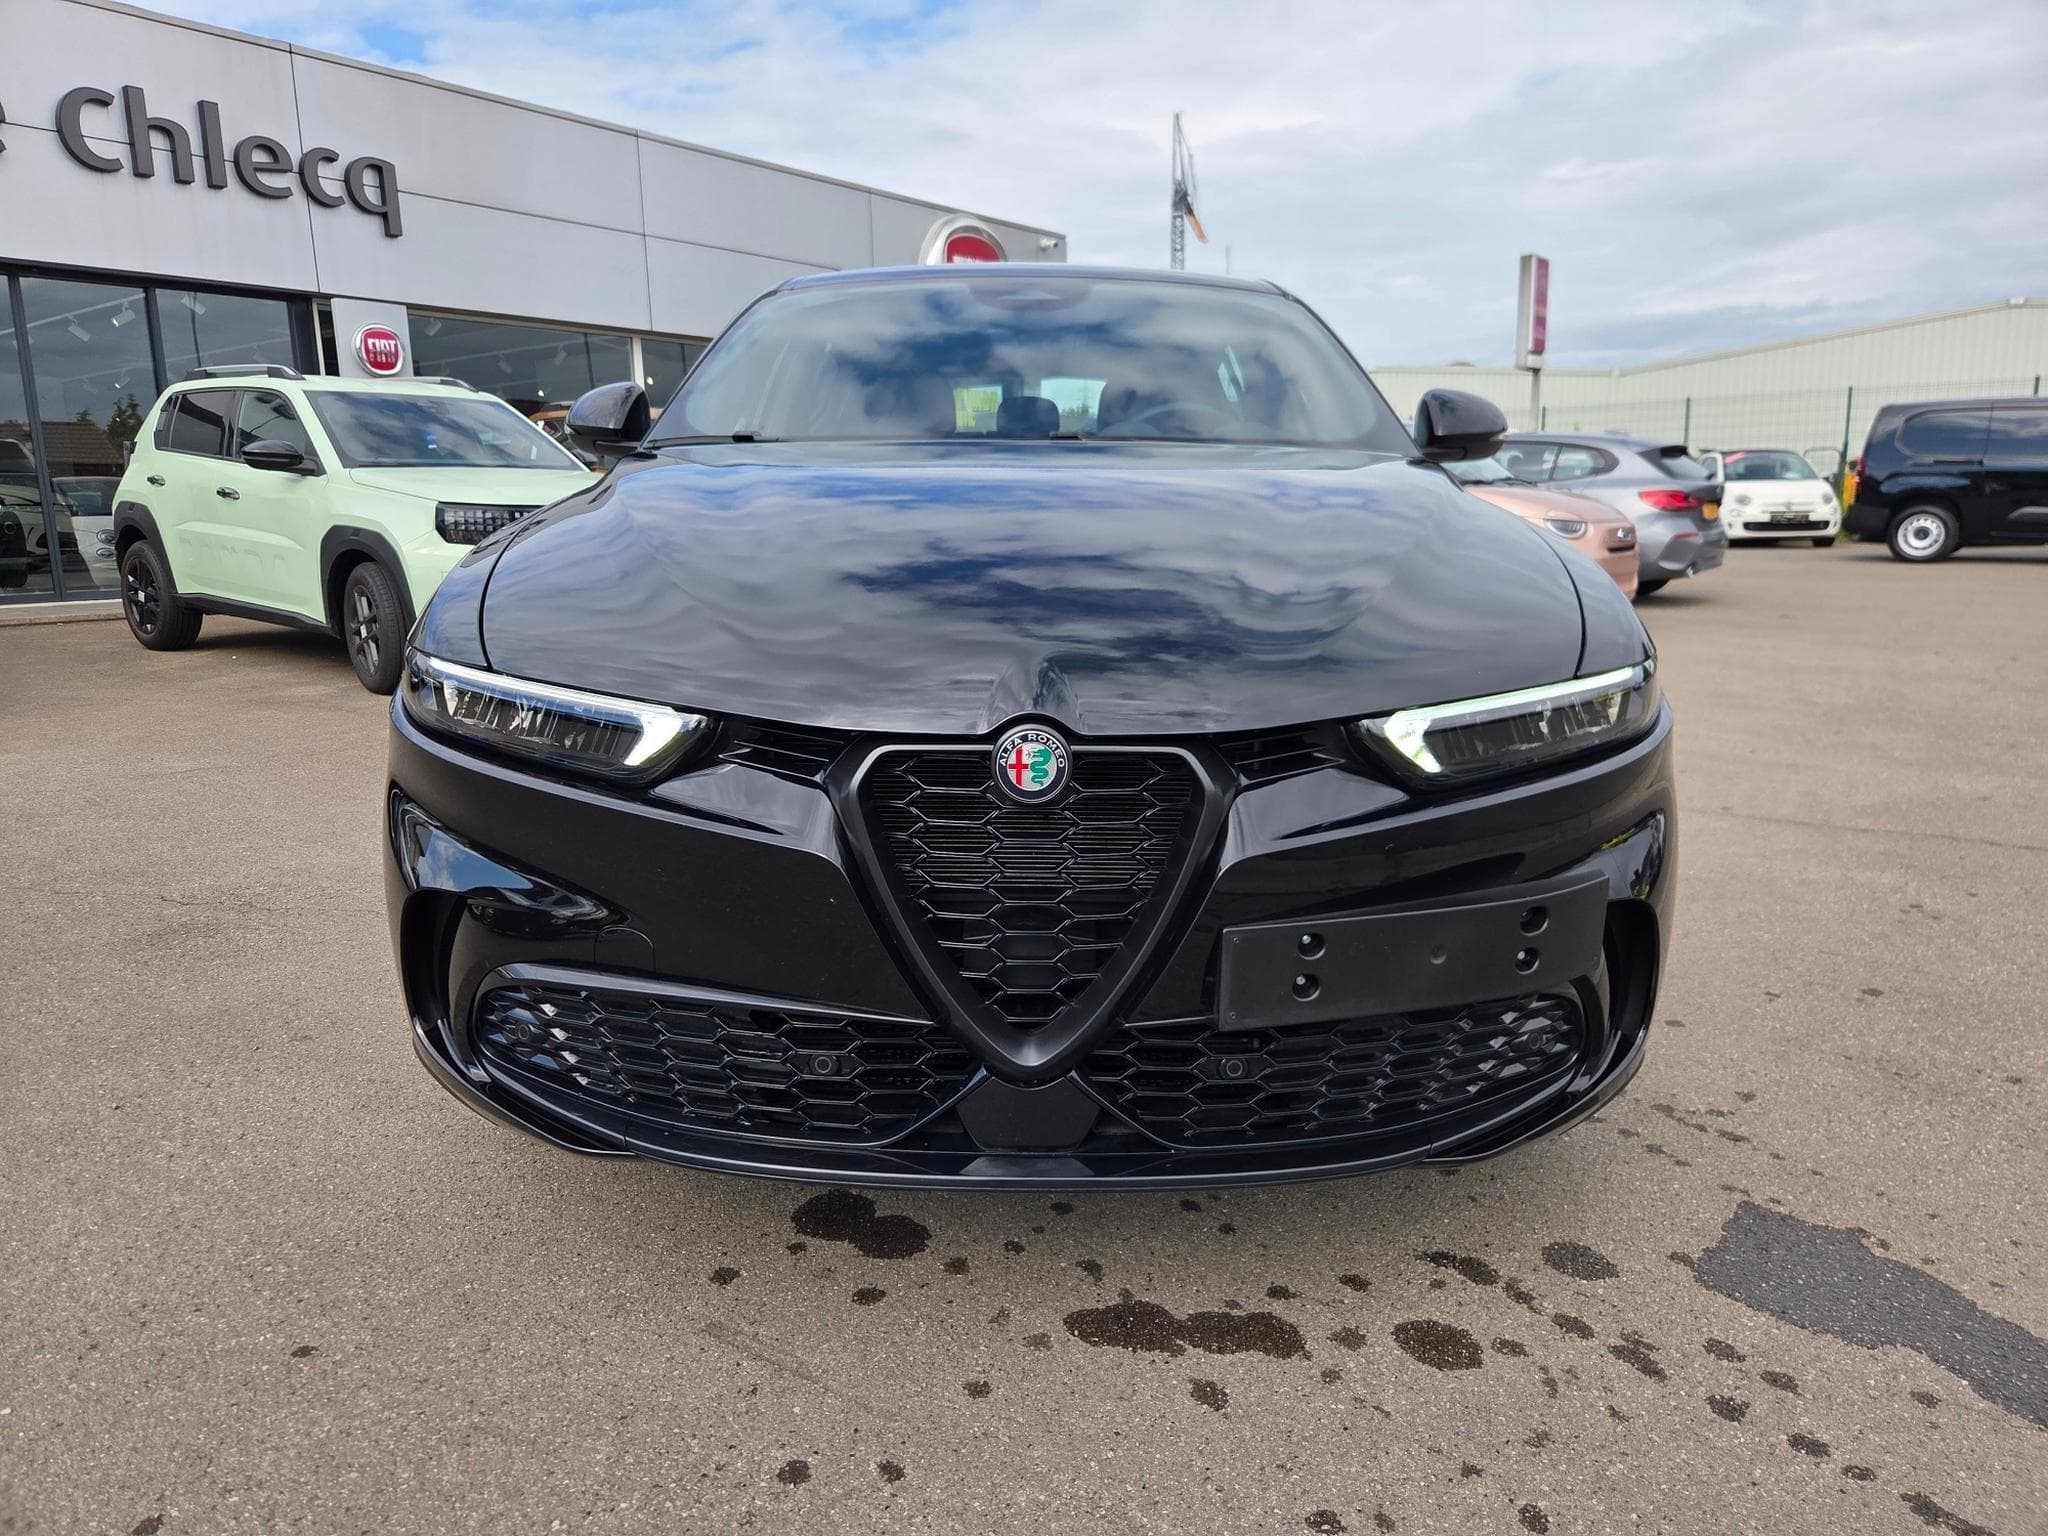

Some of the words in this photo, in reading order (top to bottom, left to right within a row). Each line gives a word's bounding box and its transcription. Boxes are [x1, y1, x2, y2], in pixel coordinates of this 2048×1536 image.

[56, 85, 403, 238] Chlecq
[366, 337, 397, 363] FIAT
[999, 737, 1023, 767] ALFA
[1028, 733, 1065, 768] ROMEO
